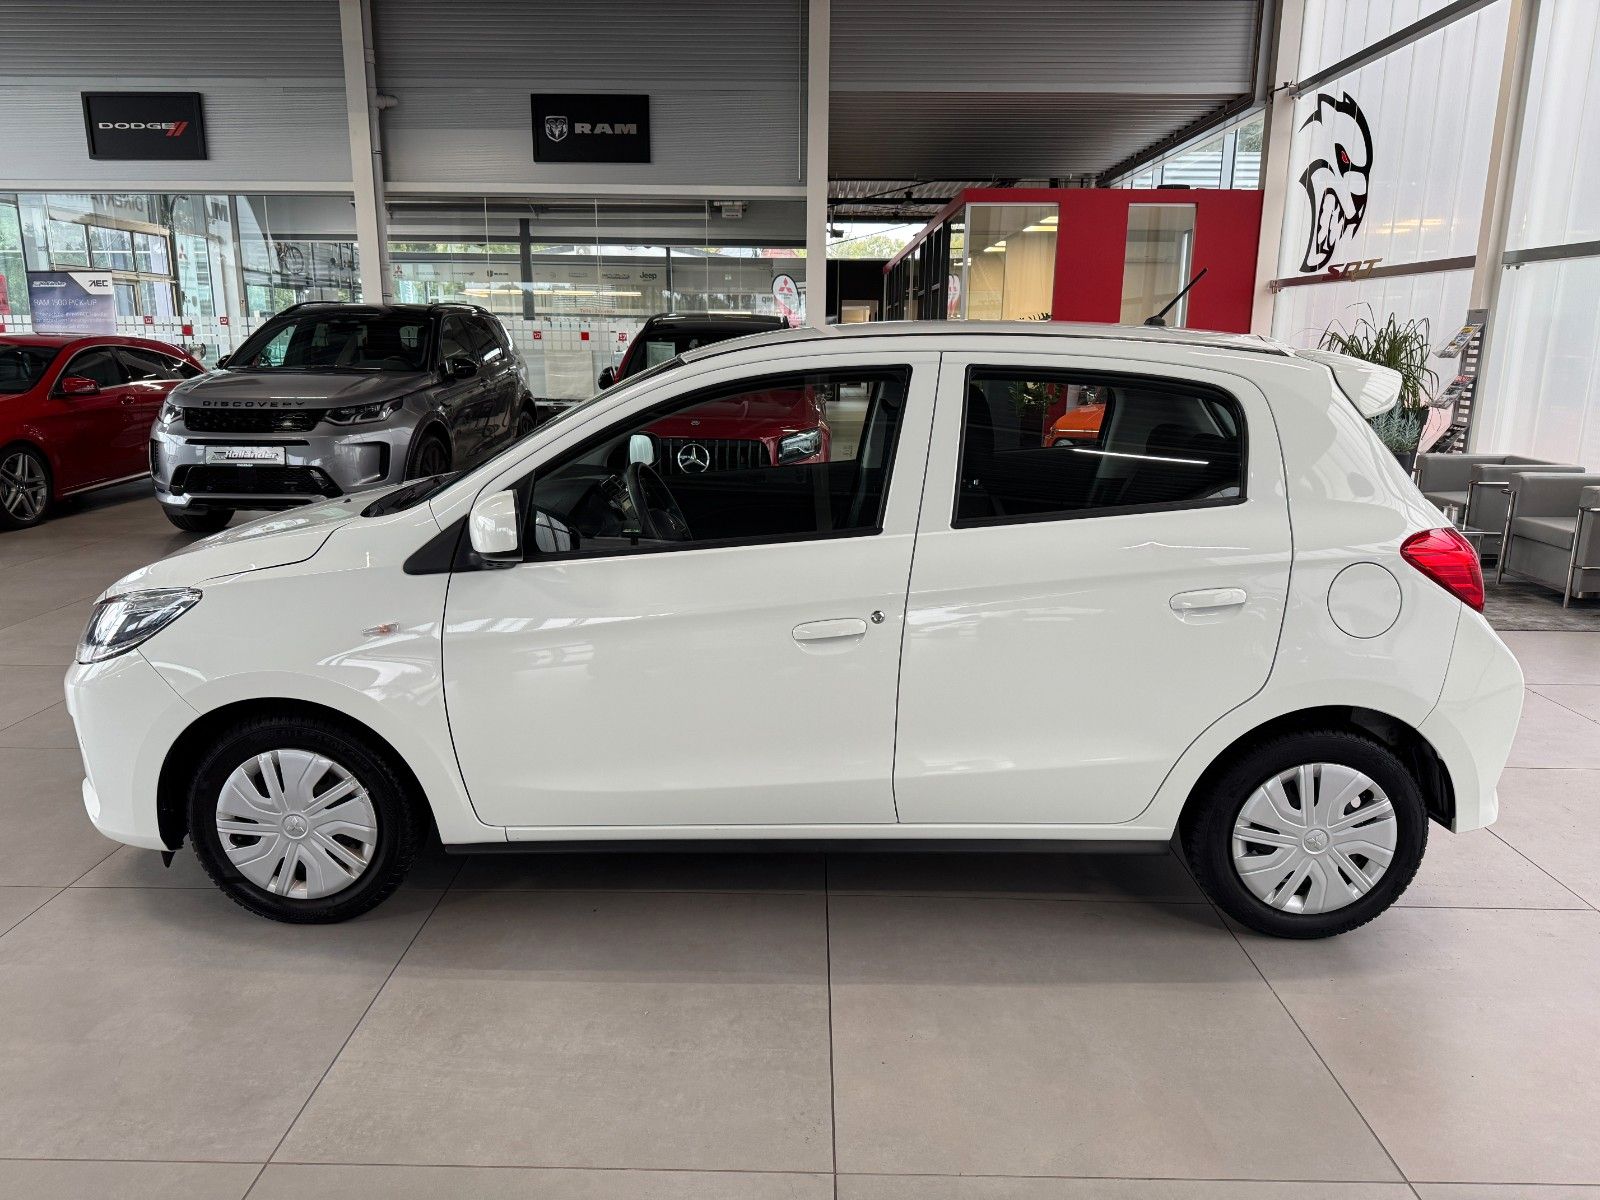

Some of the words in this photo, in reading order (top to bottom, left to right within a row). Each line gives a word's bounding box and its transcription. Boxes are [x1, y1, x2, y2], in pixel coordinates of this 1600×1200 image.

[98, 122, 177, 130] DODGE
[574, 122, 637, 135] RAM
[639, 271, 658, 280] Jeep
